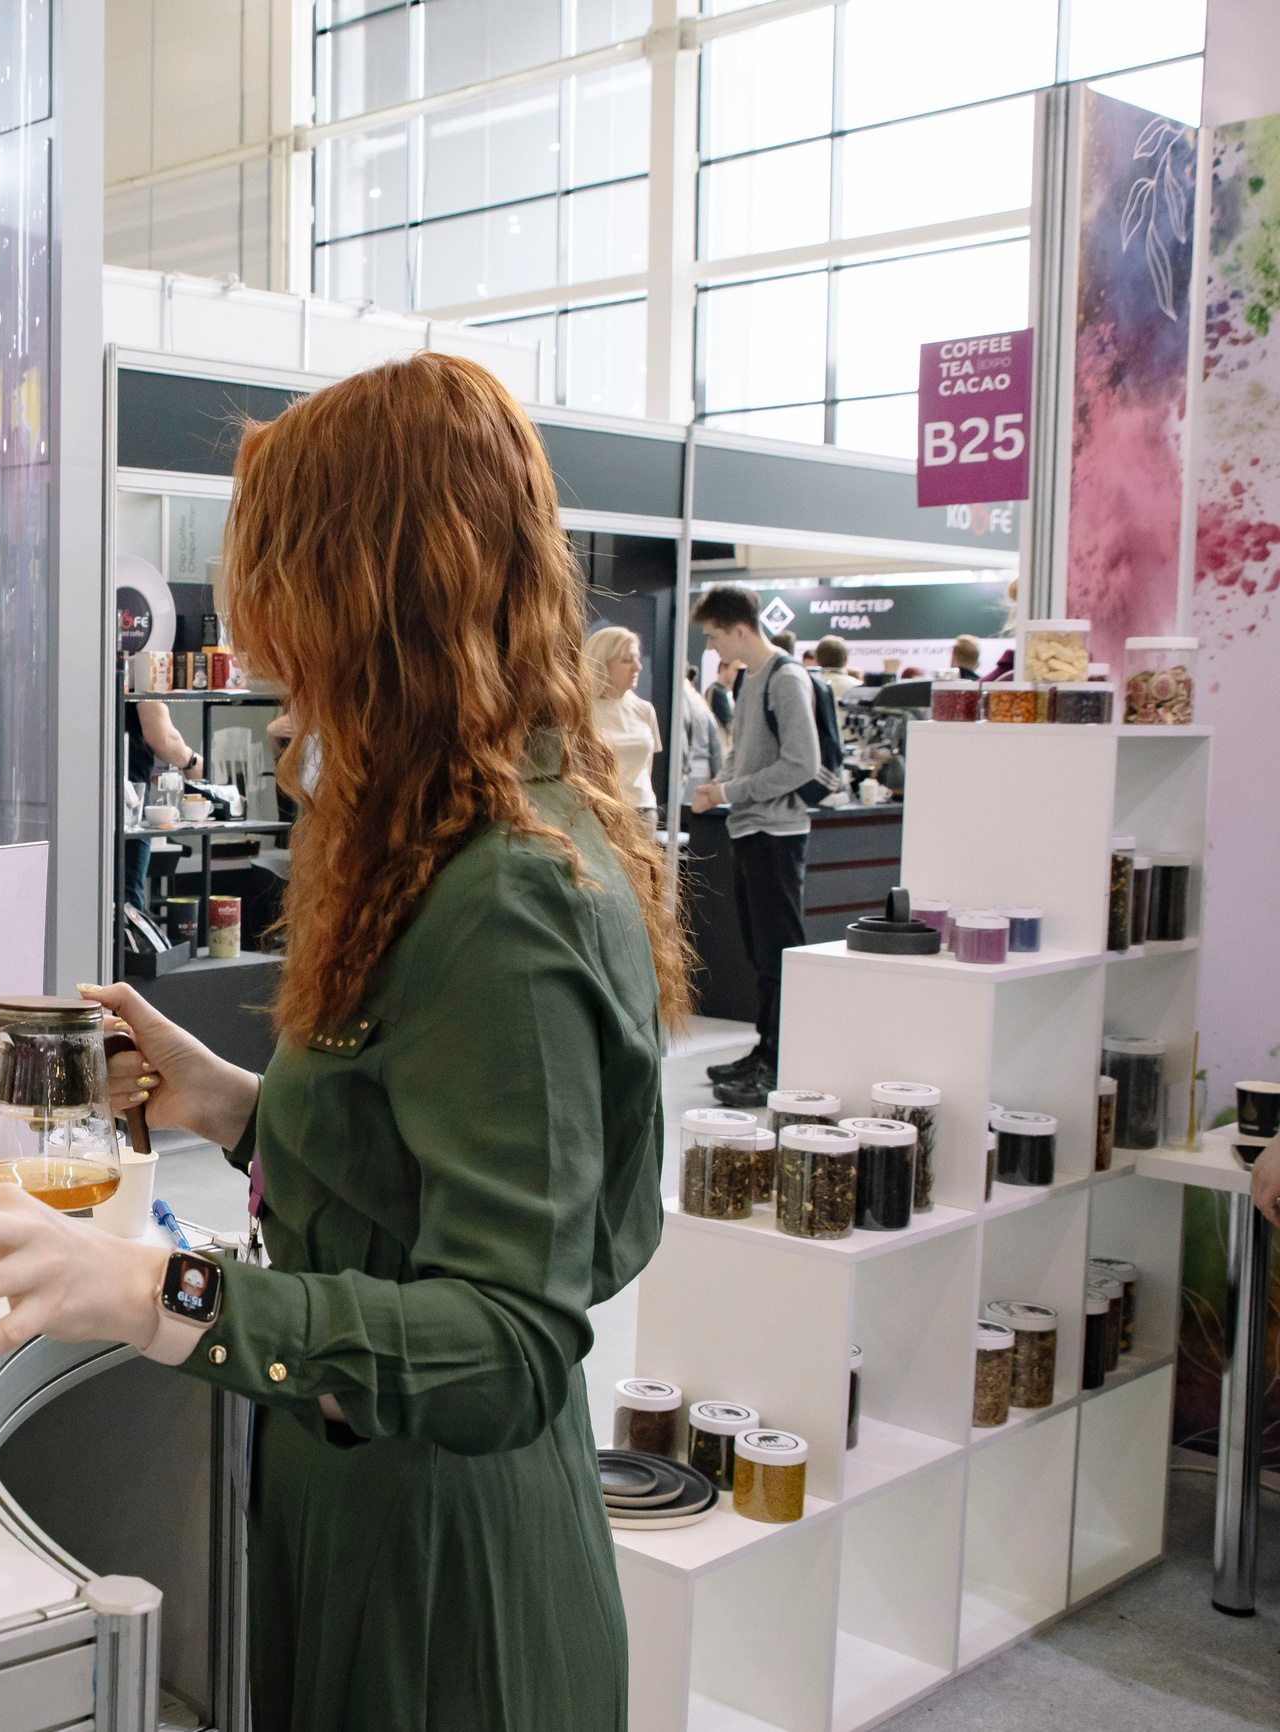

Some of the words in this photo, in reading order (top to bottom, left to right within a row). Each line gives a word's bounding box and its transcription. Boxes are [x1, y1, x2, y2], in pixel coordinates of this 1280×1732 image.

[939, 336, 1012, 360] COFFEE
[938, 360, 974, 378] TEA
[938, 373, 1011, 396] CACAO
[923, 413, 1025, 467] B25
[810, 599, 894, 615] КАПТЕСТЕР
[830, 615, 871, 631] ГОДА
